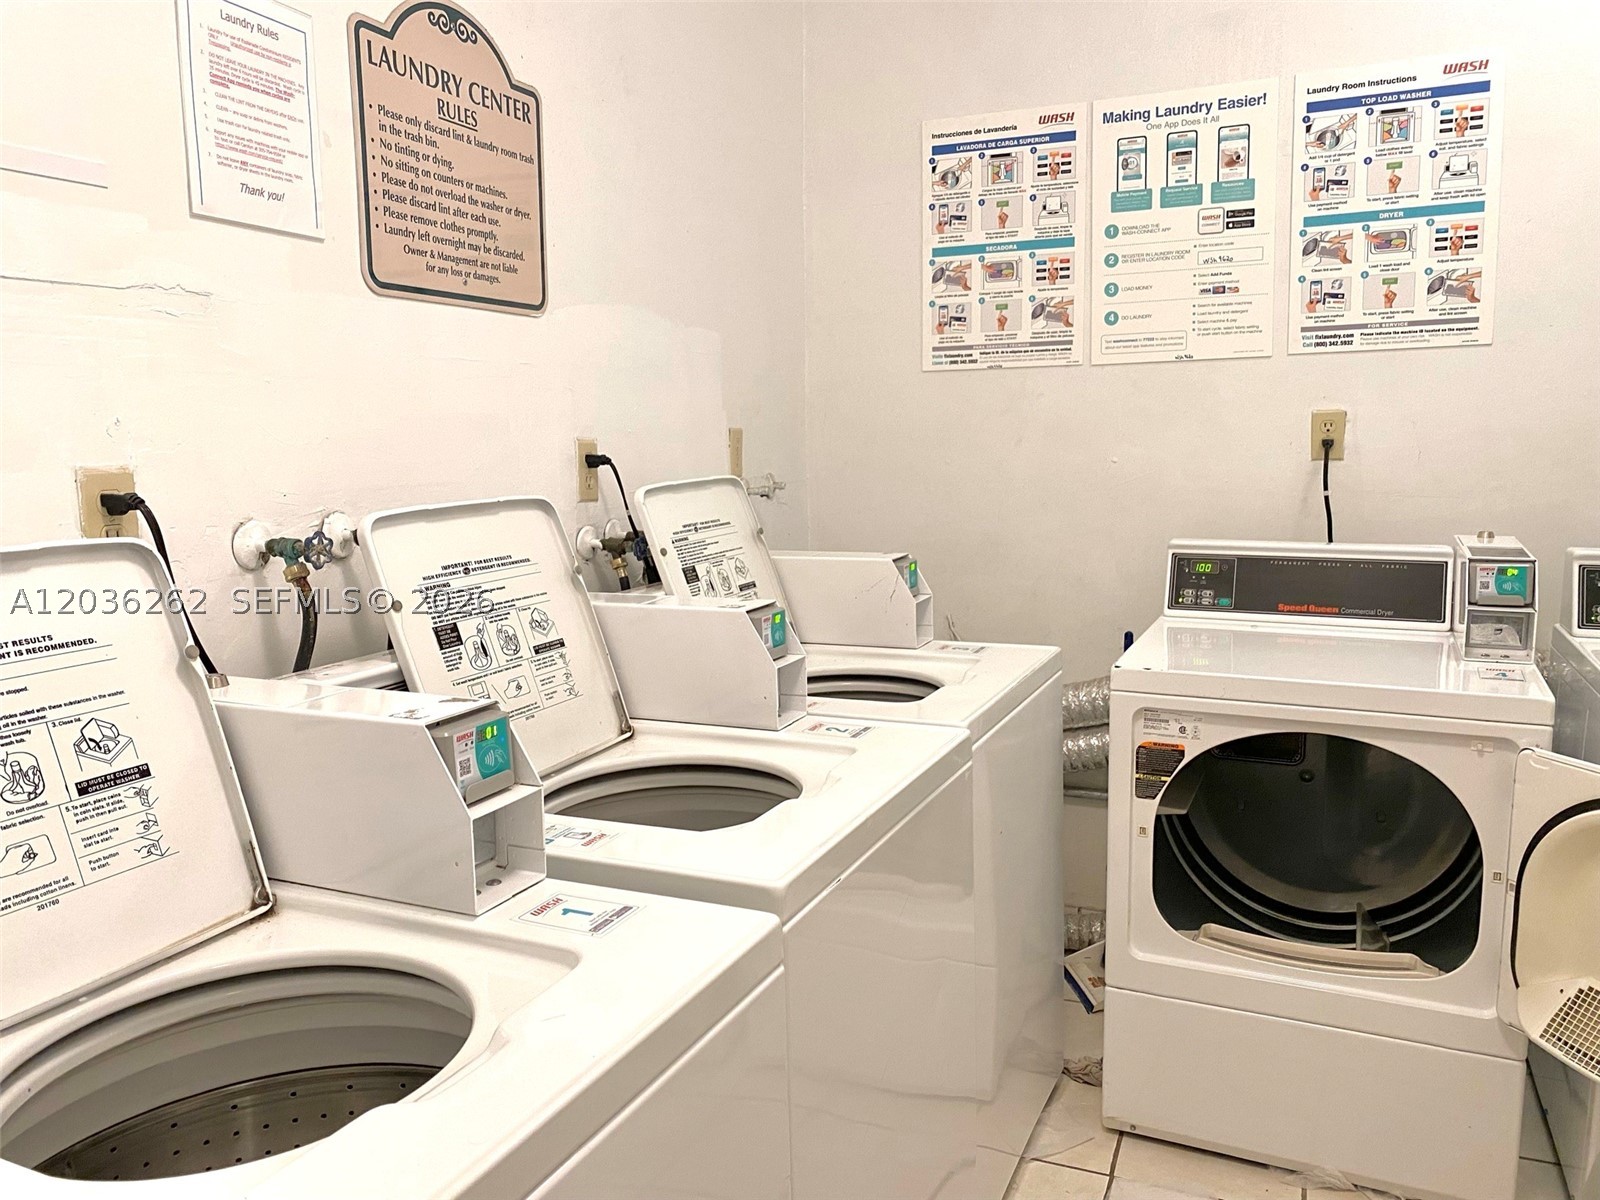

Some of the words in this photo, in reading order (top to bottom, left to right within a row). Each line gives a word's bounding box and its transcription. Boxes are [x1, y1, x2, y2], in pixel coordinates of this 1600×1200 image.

[220, 9, 254, 33] Laundry
[257, 23, 279, 40] Rules
[1443, 60, 1489, 74] WASH
[366, 39, 462, 98] LAUNDRY
[468, 82, 532, 124] CENTER
[1307, 85, 1340, 95] Laundry
[1342, 82, 1365, 90] Room
[1368, 75, 1417, 87] Instructions
[1400, 91, 1431, 100] WASHER
[437, 98, 478, 127] RULES
[1102, 109, 1150, 124] Making
[1156, 101, 1213, 118] Laundry
[1218, 93, 1267, 110] Easier!
[1039, 112, 1074, 124] WASH
[1164, 121, 1179, 130] App
[1181, 119, 1201, 127] Does
[378, 104, 403, 122] Please
[405, 113, 422, 130] only
[424, 120, 450, 138] discard
[452, 129, 464, 142] lint
[466, 135, 472, 145] &
[473, 137, 499, 156] laundry
[501, 148, 518, 160] room
[519, 151, 534, 165] trash
[379, 120, 387, 131] in
[389, 122, 402, 135] the
[404, 127, 423, 145] trash
[425, 134, 440, 149] bin.
[932, 129, 973, 139] Instrucciones
[983, 125, 1017, 133] Lavandería
[380, 138, 392, 150] No
[395, 143, 420, 162] tinting
[422, 152, 430, 162] or
[432, 155, 454, 171] dying.
[956, 143, 987, 151] LAVADORA
[381, 155, 393, 168] No
[395, 160, 419, 178] sitting
[422, 170, 431, 178] on
[433, 171, 464, 187] counters
[466, 181, 473, 189] or
[475, 183, 508, 199] machines.
[240, 183, 265, 198] Thank
[267, 192, 285, 202] you!
[382, 172, 406, 188] Please
[409, 178, 418, 191] do
[421, 185, 433, 194] not
[435, 187, 466, 203] overload
[468, 195, 478, 207] the
[481, 200, 503, 213] washer
[505, 206, 512, 215] or
[514, 207, 531, 220] dryer.
[383, 189, 407, 205] Please
[409, 195, 436, 212] discard
[438, 202, 450, 215] lint
[452, 208, 469, 220] after
[470, 212, 486, 224] each
[488, 217, 501, 227] use.
[1379, 211, 1404, 219] DRYER
[383, 206, 408, 222] Please
[410, 215, 438, 228] remove
[440, 218, 465, 234] clothes
[466, 228, 498, 243] promptly.
[384, 223, 416, 241] Laundry
[418, 230, 430, 242] left
[432, 235, 466, 251] overnight
[468, 243, 481, 255] may
[483, 244, 491, 255] be
[493, 246, 525, 262] discarded.
[986, 244, 1017, 252] SECADORA
[403, 245, 428, 258] Owner
[430, 250, 435, 258] &
[437, 252, 478, 267] Management
[480, 261, 489, 269] are
[491, 262, 501, 271] not
[502, 263, 518, 274] liable
[426, 263, 435, 272] for
[437, 266, 449, 276] any
[451, 267, 463, 277] loss
[473, 270, 501, 285] damages.
[441, 561, 473, 570] IMPORTANT!
[424, 582, 451, 591] WARNING
[1278, 604, 1307, 612] Speed
[1309, 605, 1339, 613] Queen
[1341, 607, 1375, 615] Commercial
[1377, 609, 1394, 617] Dryer
[12, 635, 53, 647] RESULTS
[26, 638, 97, 655] RECOMMENDED.
[457, 731, 473, 742] WASH
[88, 782, 115, 792] OPERATE
[116, 774, 140, 784] WASHER
[89, 777, 105, 785] MUST
[116, 768, 138, 778] CLOSED
[530, 898, 563, 916] WASH
[562, 908, 593, 916] 1
